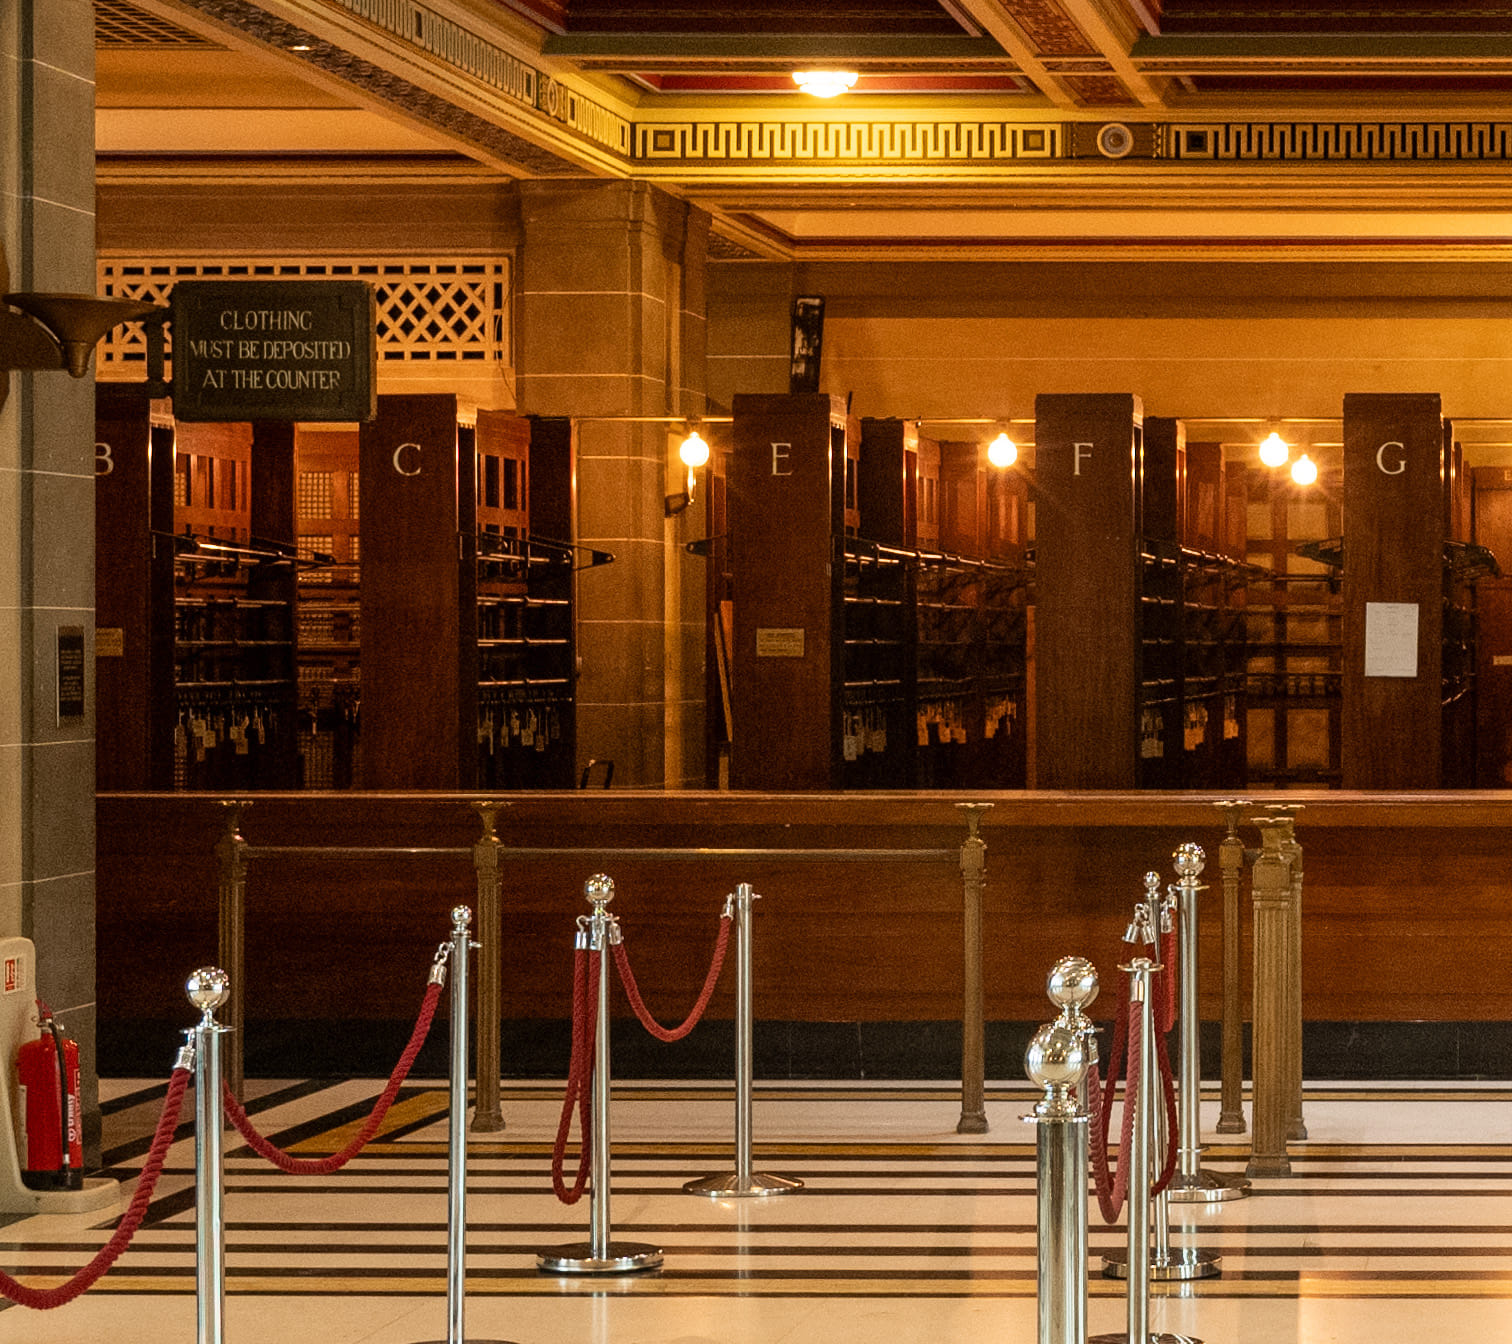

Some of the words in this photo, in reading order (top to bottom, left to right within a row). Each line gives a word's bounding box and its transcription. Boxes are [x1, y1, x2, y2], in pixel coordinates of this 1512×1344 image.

[220, 310, 313, 331] CLOTHING
[190, 340, 235, 360] MUST
[238, 340, 260, 360] BE
[263, 340, 351, 360] DEPOSITED
[202, 369, 228, 390] AT
[231, 369, 263, 390] THE
[265, 369, 341, 390] COUNTER
[94, 442, 114, 476] B
[392, 442, 422, 478] C
[770, 442, 793, 477] E
[1073, 442, 1094, 477] F
[1375, 441, 1406, 476] G
